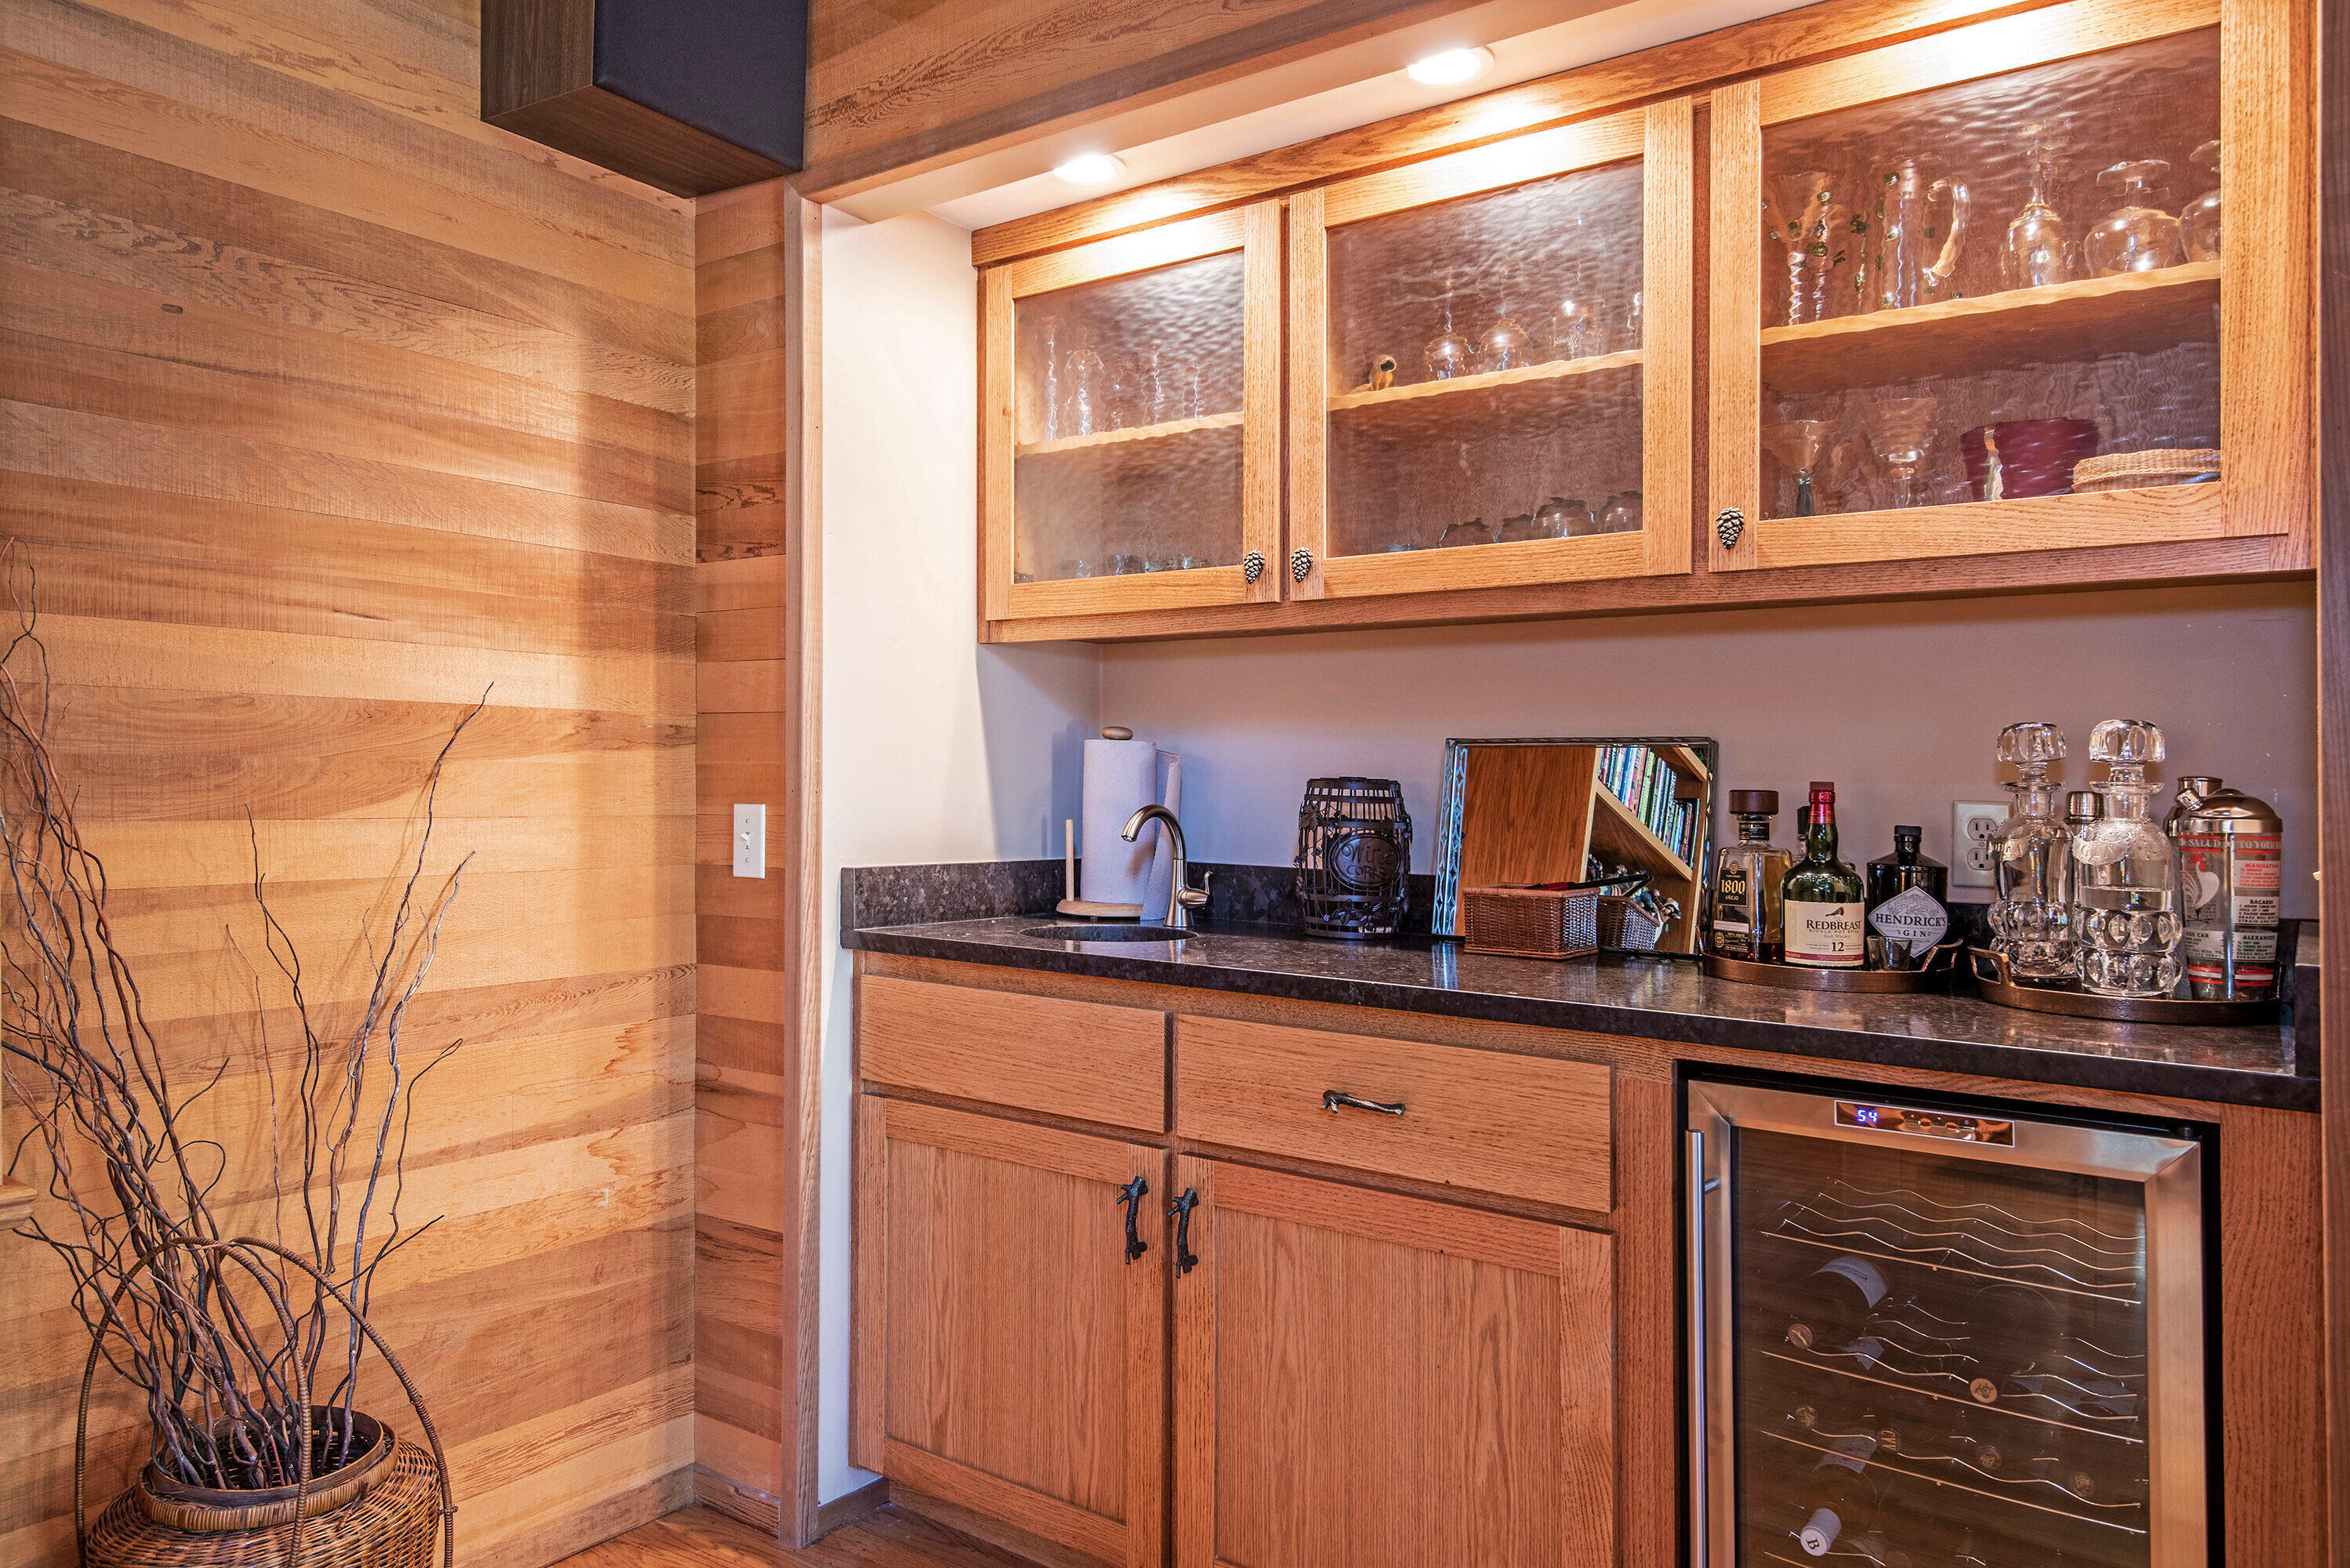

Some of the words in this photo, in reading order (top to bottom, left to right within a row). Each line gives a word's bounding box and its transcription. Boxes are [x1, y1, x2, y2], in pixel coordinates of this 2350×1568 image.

[2189, 839, 2221, 848] SALUD
[1342, 840, 1393, 865] Wine
[1720, 879, 1746, 895] 1800
[1876, 913, 1945, 927] HENDRICK'S
[1832, 942, 1844, 952] 12
[1857, 1109, 1879, 1123] 54
[1806, 1537, 1820, 1550] B
